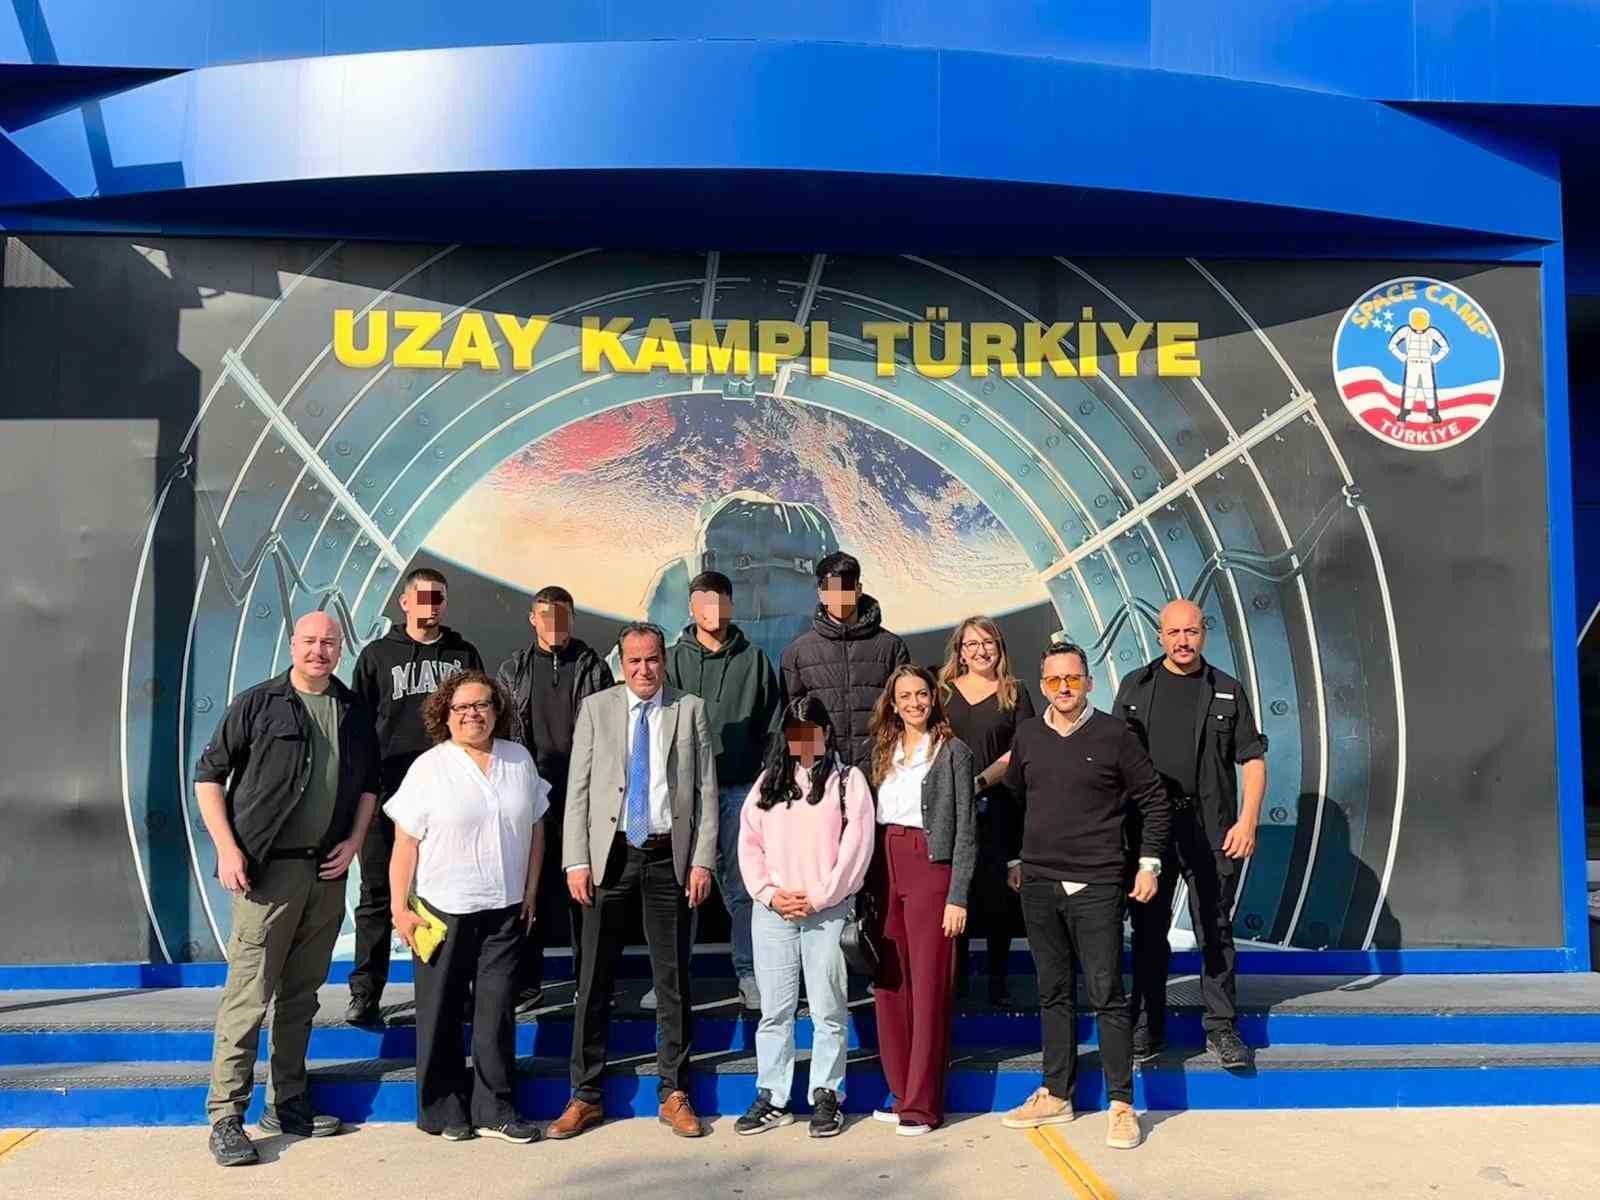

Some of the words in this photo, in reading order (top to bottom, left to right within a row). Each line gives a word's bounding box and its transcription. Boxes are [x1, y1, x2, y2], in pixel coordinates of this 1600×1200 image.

[1351, 283, 1416, 329] SPACE
[1424, 284, 1489, 336] CAMP
[334, 308, 550, 371] UZAY
[581, 316, 831, 376] KAMPI
[863, 307, 1201, 377] TÜRKİYE
[1380, 419, 1461, 443] TÜRKİYE
